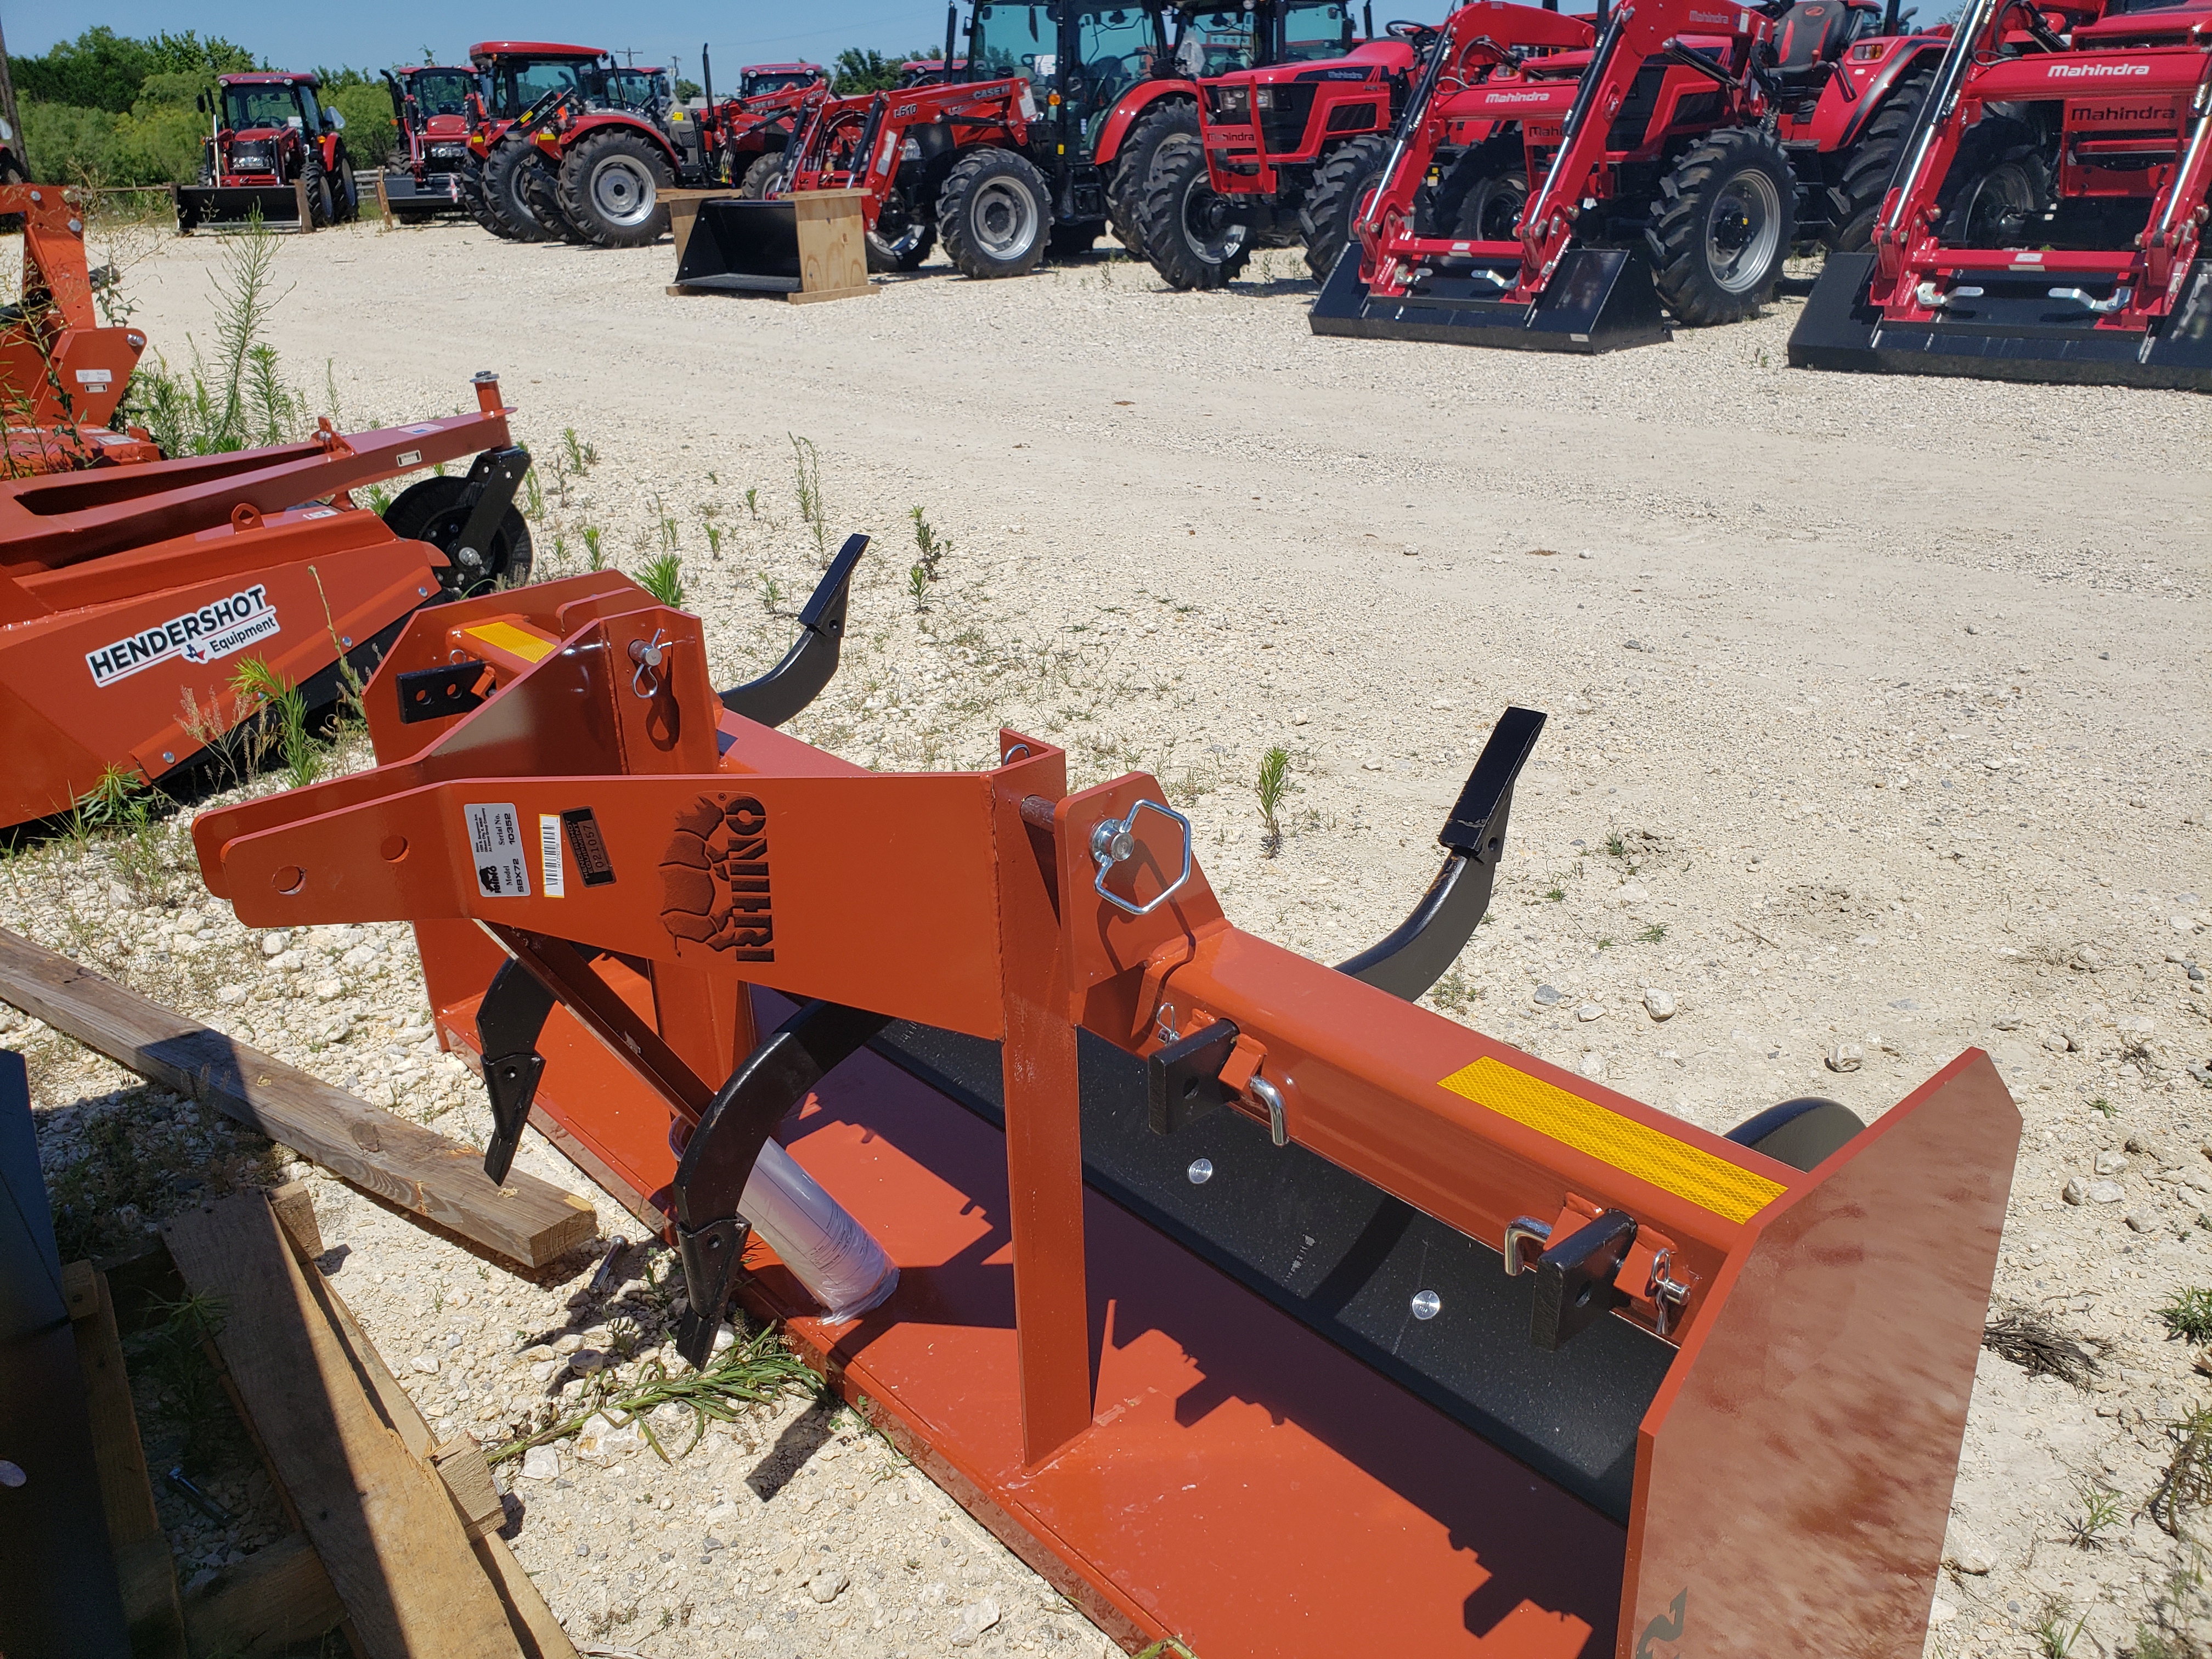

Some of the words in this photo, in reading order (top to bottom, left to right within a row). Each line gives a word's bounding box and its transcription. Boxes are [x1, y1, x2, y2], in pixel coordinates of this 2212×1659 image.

[1689, 10, 1728, 24] Mahindra
[2047, 64, 2149, 77] Mahindra
[973, 86, 1001, 100] CASE
[1485, 92, 1550, 103] Mahindra
[2071, 106, 2176, 121] Mahindra
[89, 587, 266, 678] HENDERSHOT
[209, 616, 275, 653] Equipment
[495, 826, 505, 845] Serial
[504, 812, 515, 845] 10352
[565, 819, 590, 879] HENDERSHOT
[573, 823, 593, 873] EQUIPMENT
[583, 825, 604, 868] 021057
[490, 865, 501, 894] RHINO
[503, 865, 513, 886] Model
[513, 858, 524, 893] SBX72
[725, 795, 775, 962] RHINO
